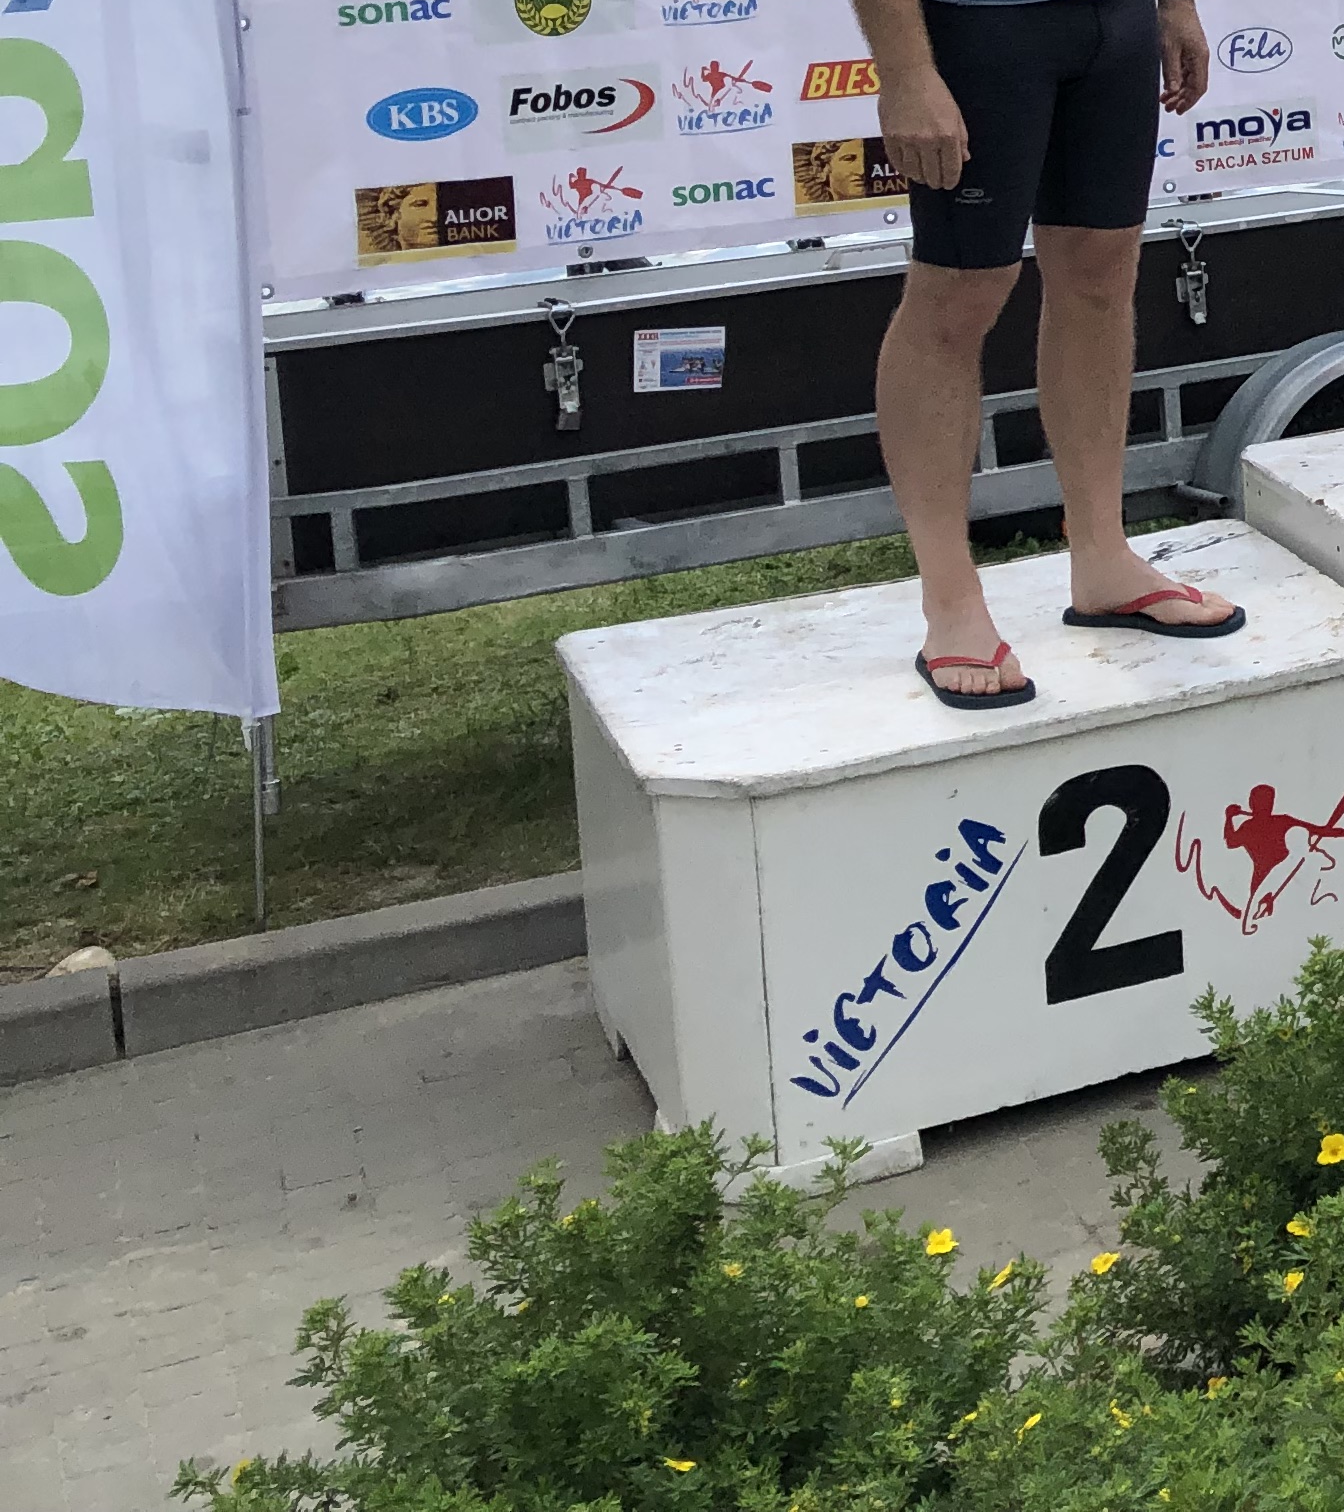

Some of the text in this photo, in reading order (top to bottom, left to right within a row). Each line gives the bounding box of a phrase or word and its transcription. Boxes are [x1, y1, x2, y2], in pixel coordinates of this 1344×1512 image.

[1228, 32, 1286, 67] Fila
[388, 98, 459, 130] KBS
[509, 84, 616, 116] Fobos
[1196, 107, 1311, 146] moya
[1195, 147, 1314, 173] STACJA SZTUM
[672, 177, 775, 206] sonac
[444, 205, 509, 225] ALIOR
[447, 226, 499, 242] BANK
[1037, 764, 1185, 1006] 2
